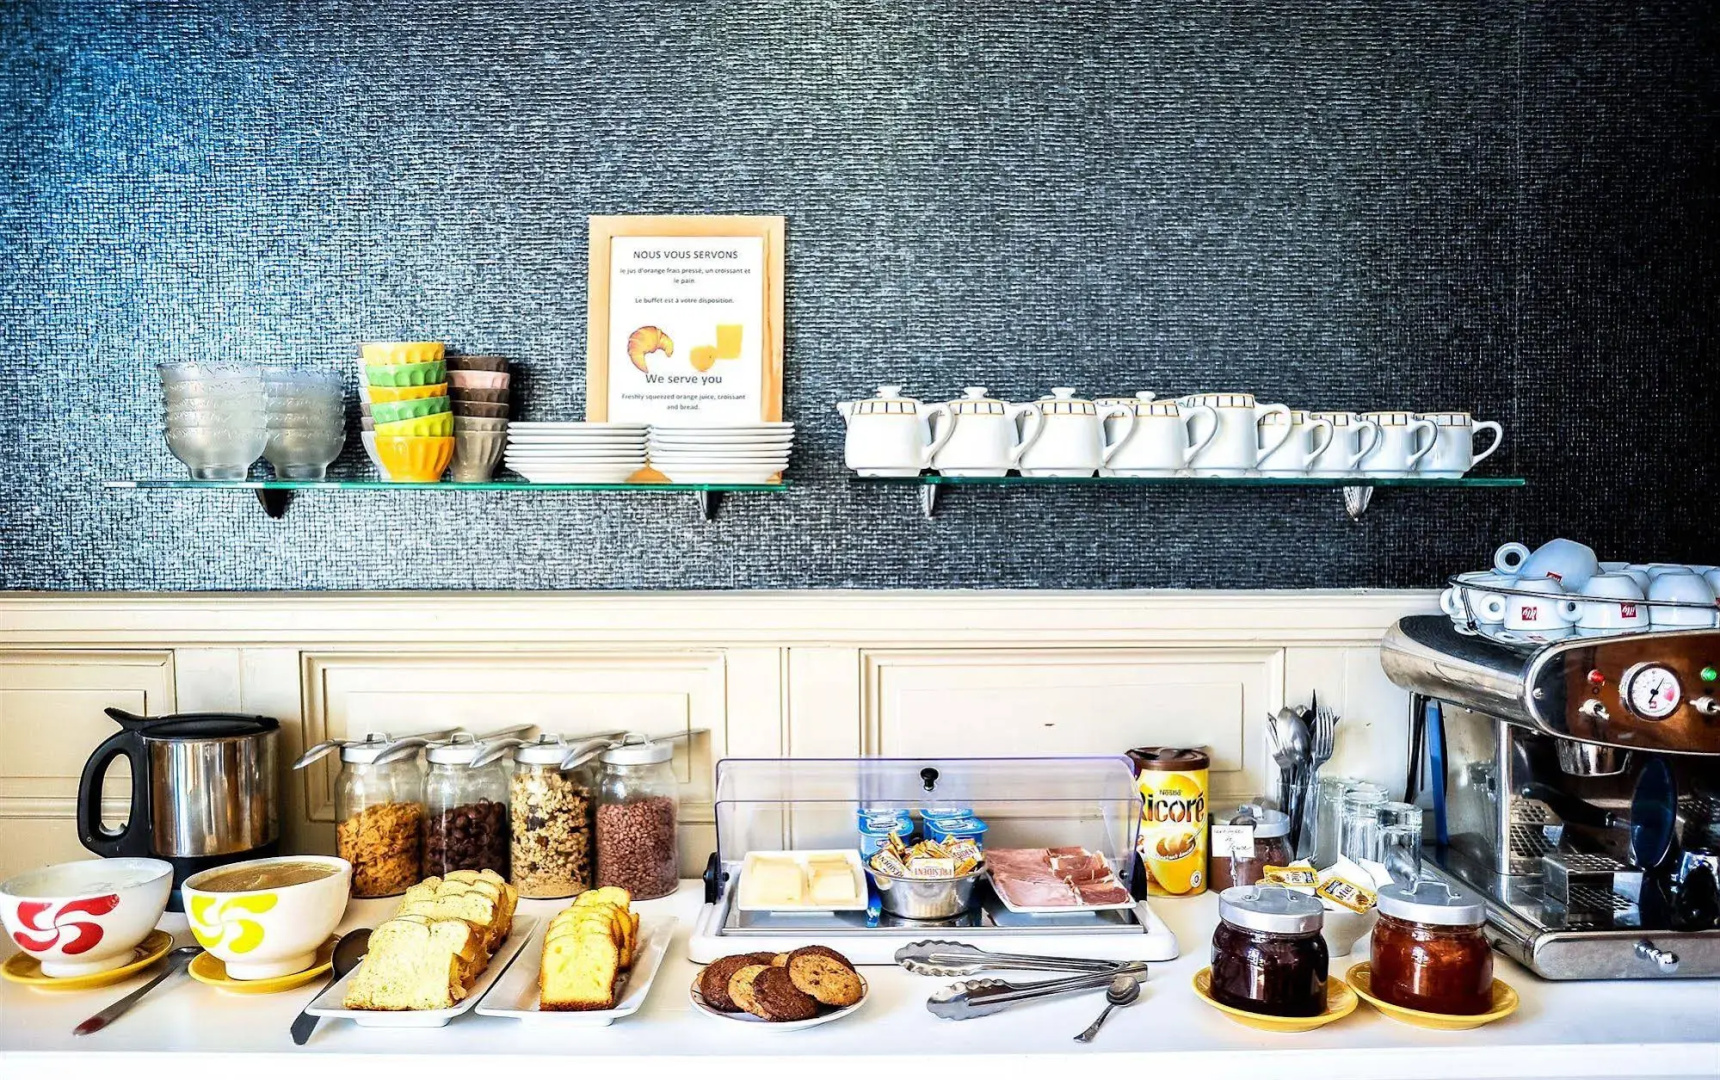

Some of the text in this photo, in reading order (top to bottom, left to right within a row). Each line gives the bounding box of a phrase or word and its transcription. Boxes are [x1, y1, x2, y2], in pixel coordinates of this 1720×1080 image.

[633, 250, 739, 260] NOUS VOUS SERVONS
[627, 267, 636, 276] jus
[637, 267, 666, 276] d'orange
[643, 296, 663, 304] buffet
[698, 296, 735, 306] disposition.
[645, 374, 723, 387] We serve you
[621, 393, 746, 402] Freshly squeezed orange juice, croissant
[666, 403, 700, 411] and bread.
[1522, 607, 1537, 620] illy
[1621, 603, 1636, 617] illy
[1335, 884, 1354, 901] Miel
